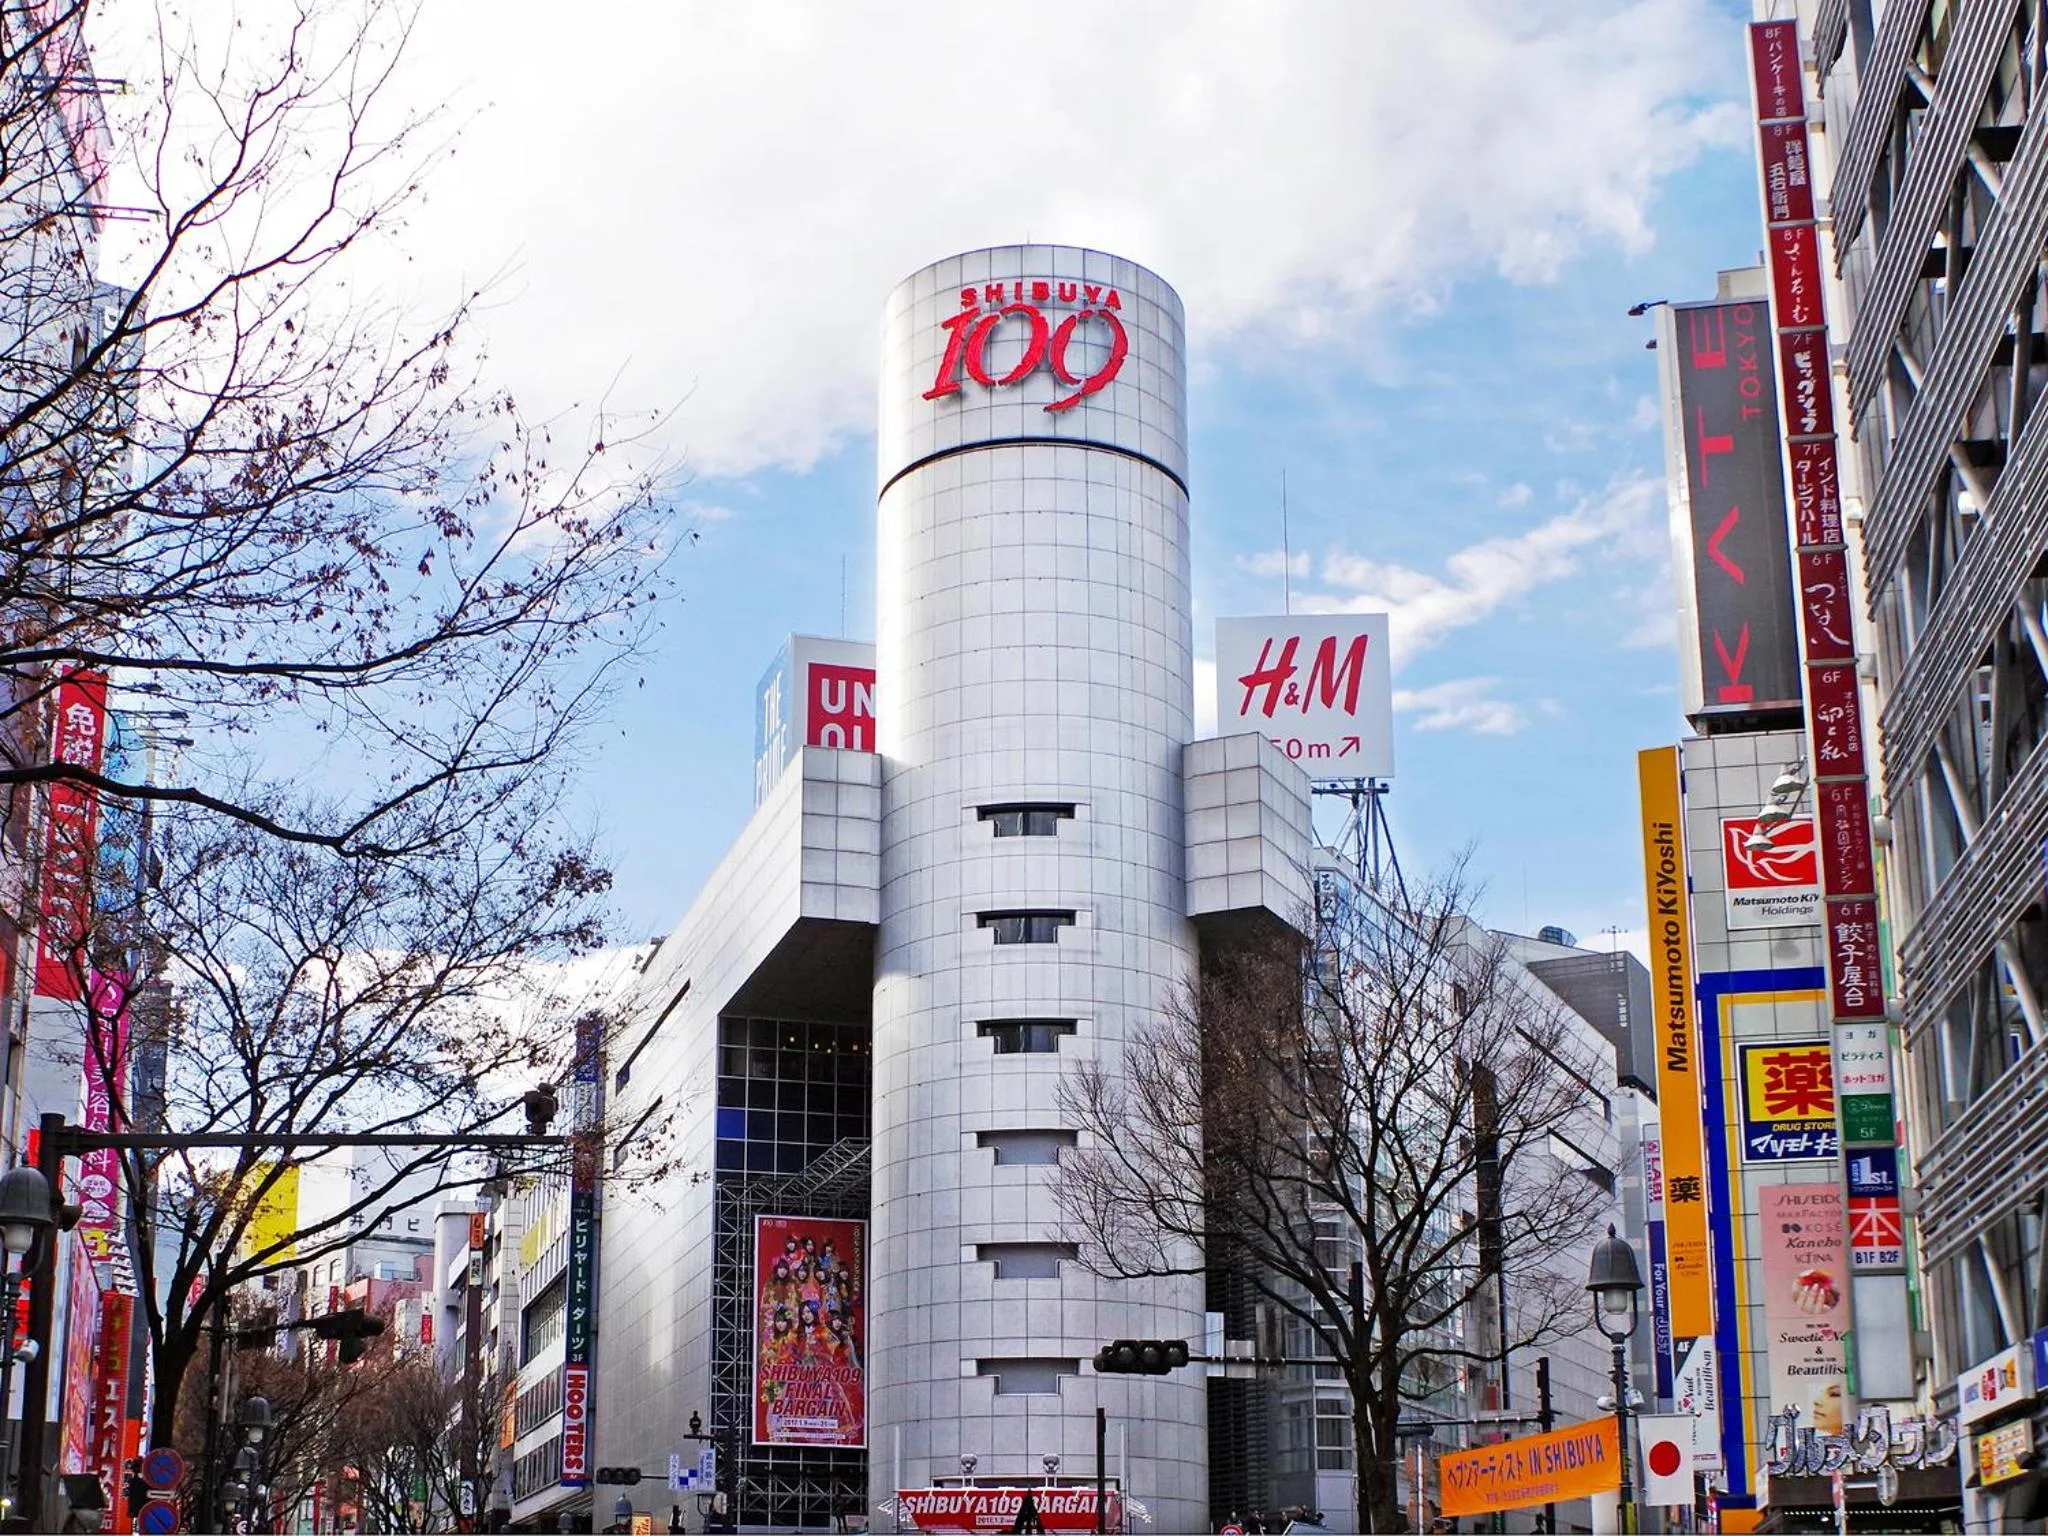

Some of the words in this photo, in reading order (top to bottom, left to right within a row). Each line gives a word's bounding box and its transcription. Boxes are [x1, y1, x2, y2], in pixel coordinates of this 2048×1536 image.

[960, 280, 1122, 311] SHIBUYA
[1792, 333, 1813, 348] 7F
[921, 302, 1129, 413] 109
[1732, 303, 1764, 422] TOKYO
[1803, 443, 1822, 456] 7F
[1796, 460, 1819, 545] タージマハール
[1818, 456, 1840, 544] インド料理店
[1811, 554, 1833, 567] 6F
[1237, 633, 1369, 719] H&M
[1821, 670, 1842, 684] 6F
[1831, 787, 1853, 802] 6F
[1653, 821, 1679, 919] KiYoshi
[1732, 895, 1798, 908] Matsumoto
[1761, 904, 1814, 917] Holdings
[1841, 903, 1863, 916] 6F
[1834, 922, 1868, 1007] 餃子屋台
[1665, 919, 1688, 1073] Matsumoto
[1761, 1050, 1834, 1116] 薬
[1772, 1123, 1801, 1132] DRUG
[1652, 1157, 1663, 1202] LABI
[1669, 1175, 1701, 1204] 薬
[1855, 1251, 1876, 1264] B1F
[1879, 1250, 1899, 1264] B2F
[571, 1219, 588, 1350] ビリヤード・ダーツ
[1654, 1263, 1666, 1281] For
[1655, 1282, 1668, 1312] Your
[759, 1363, 863, 1385] SHIBUYA109
[784, 1381, 832, 1400] FINAL
[564, 1373, 587, 1470] HOOTERS
[772, 1398, 847, 1417] BARGAIN
[1446, 1451, 1524, 1490] ヘブンアーティスト
[1528, 1448, 1542, 1476] IN
[1546, 1433, 1605, 1474] SHIBUYA
[907, 1495, 1023, 1515] SHIBUYA109
